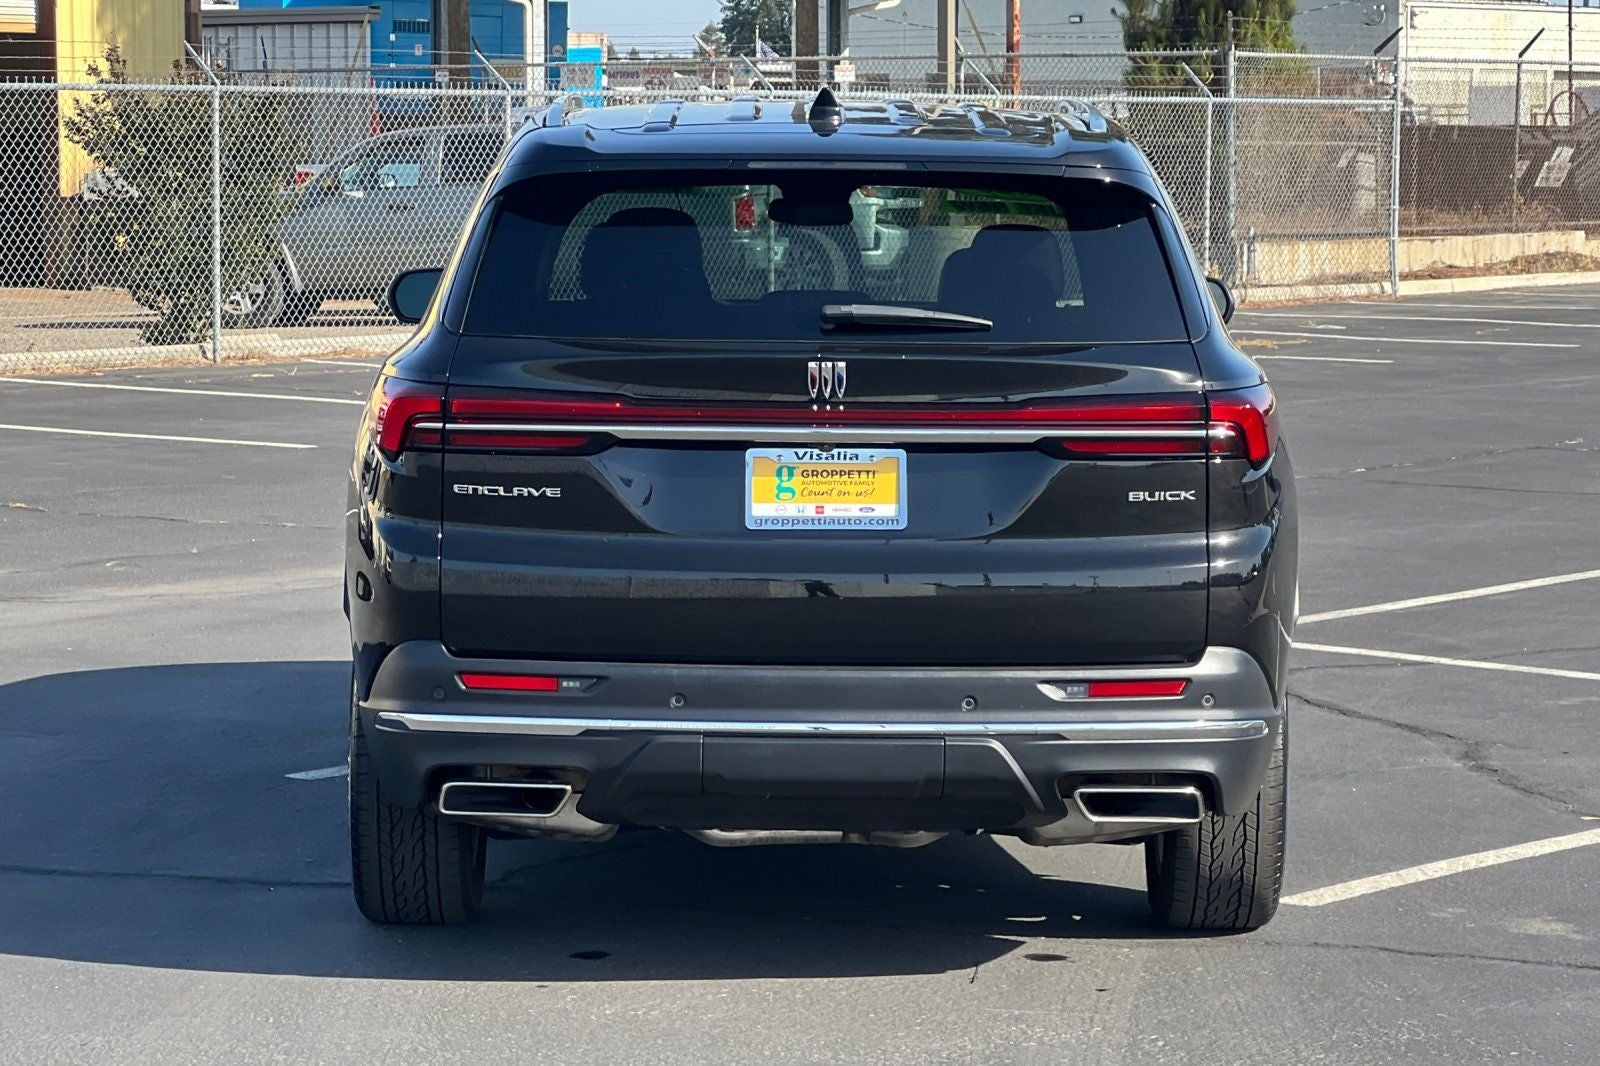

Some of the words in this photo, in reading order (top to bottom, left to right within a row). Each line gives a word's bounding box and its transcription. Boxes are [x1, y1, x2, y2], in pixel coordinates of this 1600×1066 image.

[794, 451, 859, 461] Visalia
[801, 469, 876, 479] GROPPETTI
[453, 484, 561, 497] ENCLAVE
[800, 487, 835, 497] Count
[837, 489, 851, 497] on
[855, 487, 876, 497] us!
[1128, 490, 1196, 501] BUICK
[754, 516, 900, 527] groppettiauto.com
